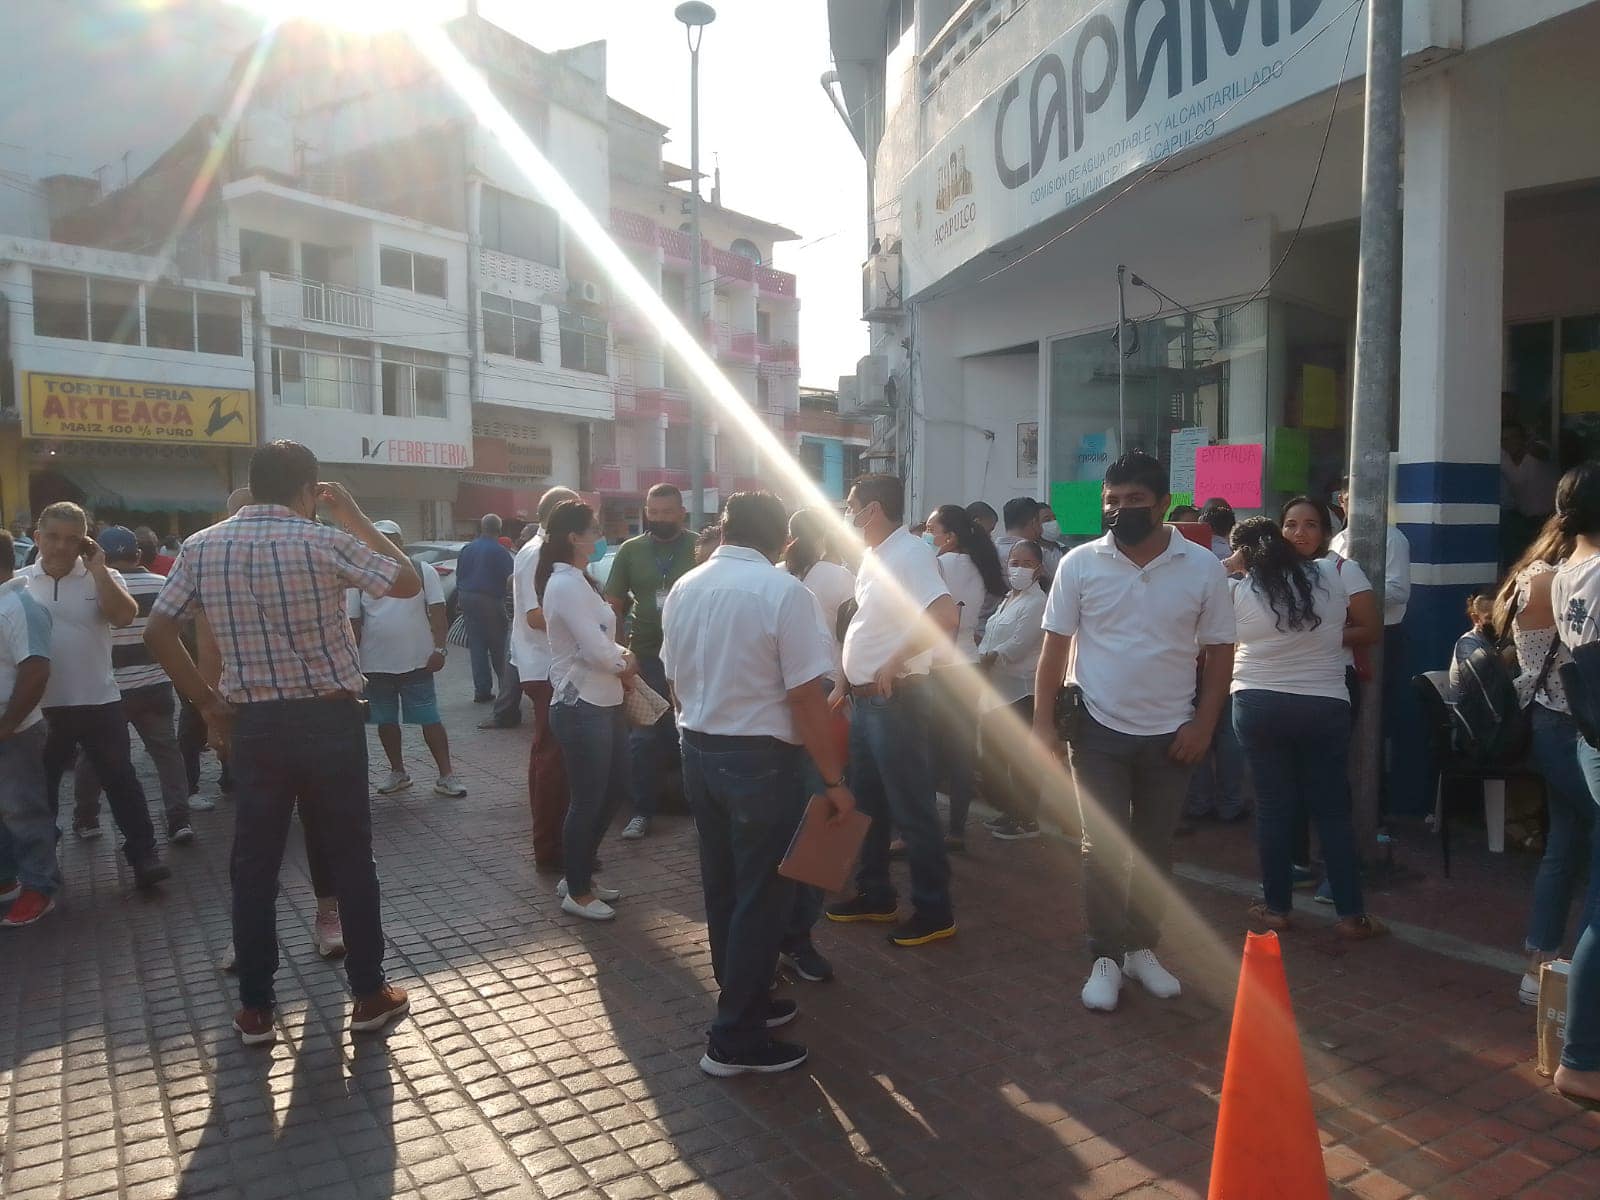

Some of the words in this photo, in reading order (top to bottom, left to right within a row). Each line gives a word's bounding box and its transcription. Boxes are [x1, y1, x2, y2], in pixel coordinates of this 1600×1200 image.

[1069, 163, 1081, 184] DE
[1082, 151, 1106, 178] AGUA
[1107, 124, 1152, 163] POTABLE
[1154, 119, 1163, 136] Y
[1165, 60, 1283, 130] ALCANTARILLADO
[1065, 184, 1081, 206] DEL
[1147, 118, 1216, 161] ACAPULCO
[934, 201, 977, 246] ACAPULCO
[44, 380, 193, 402] TORTILLERIA
[43, 396, 193, 425] ARTEAGA
[60, 421, 103, 433] MAIZ
[107, 426, 133, 434] 100
[156, 427, 194, 437] PURO
[388, 439, 468, 466] FERRETERIA
